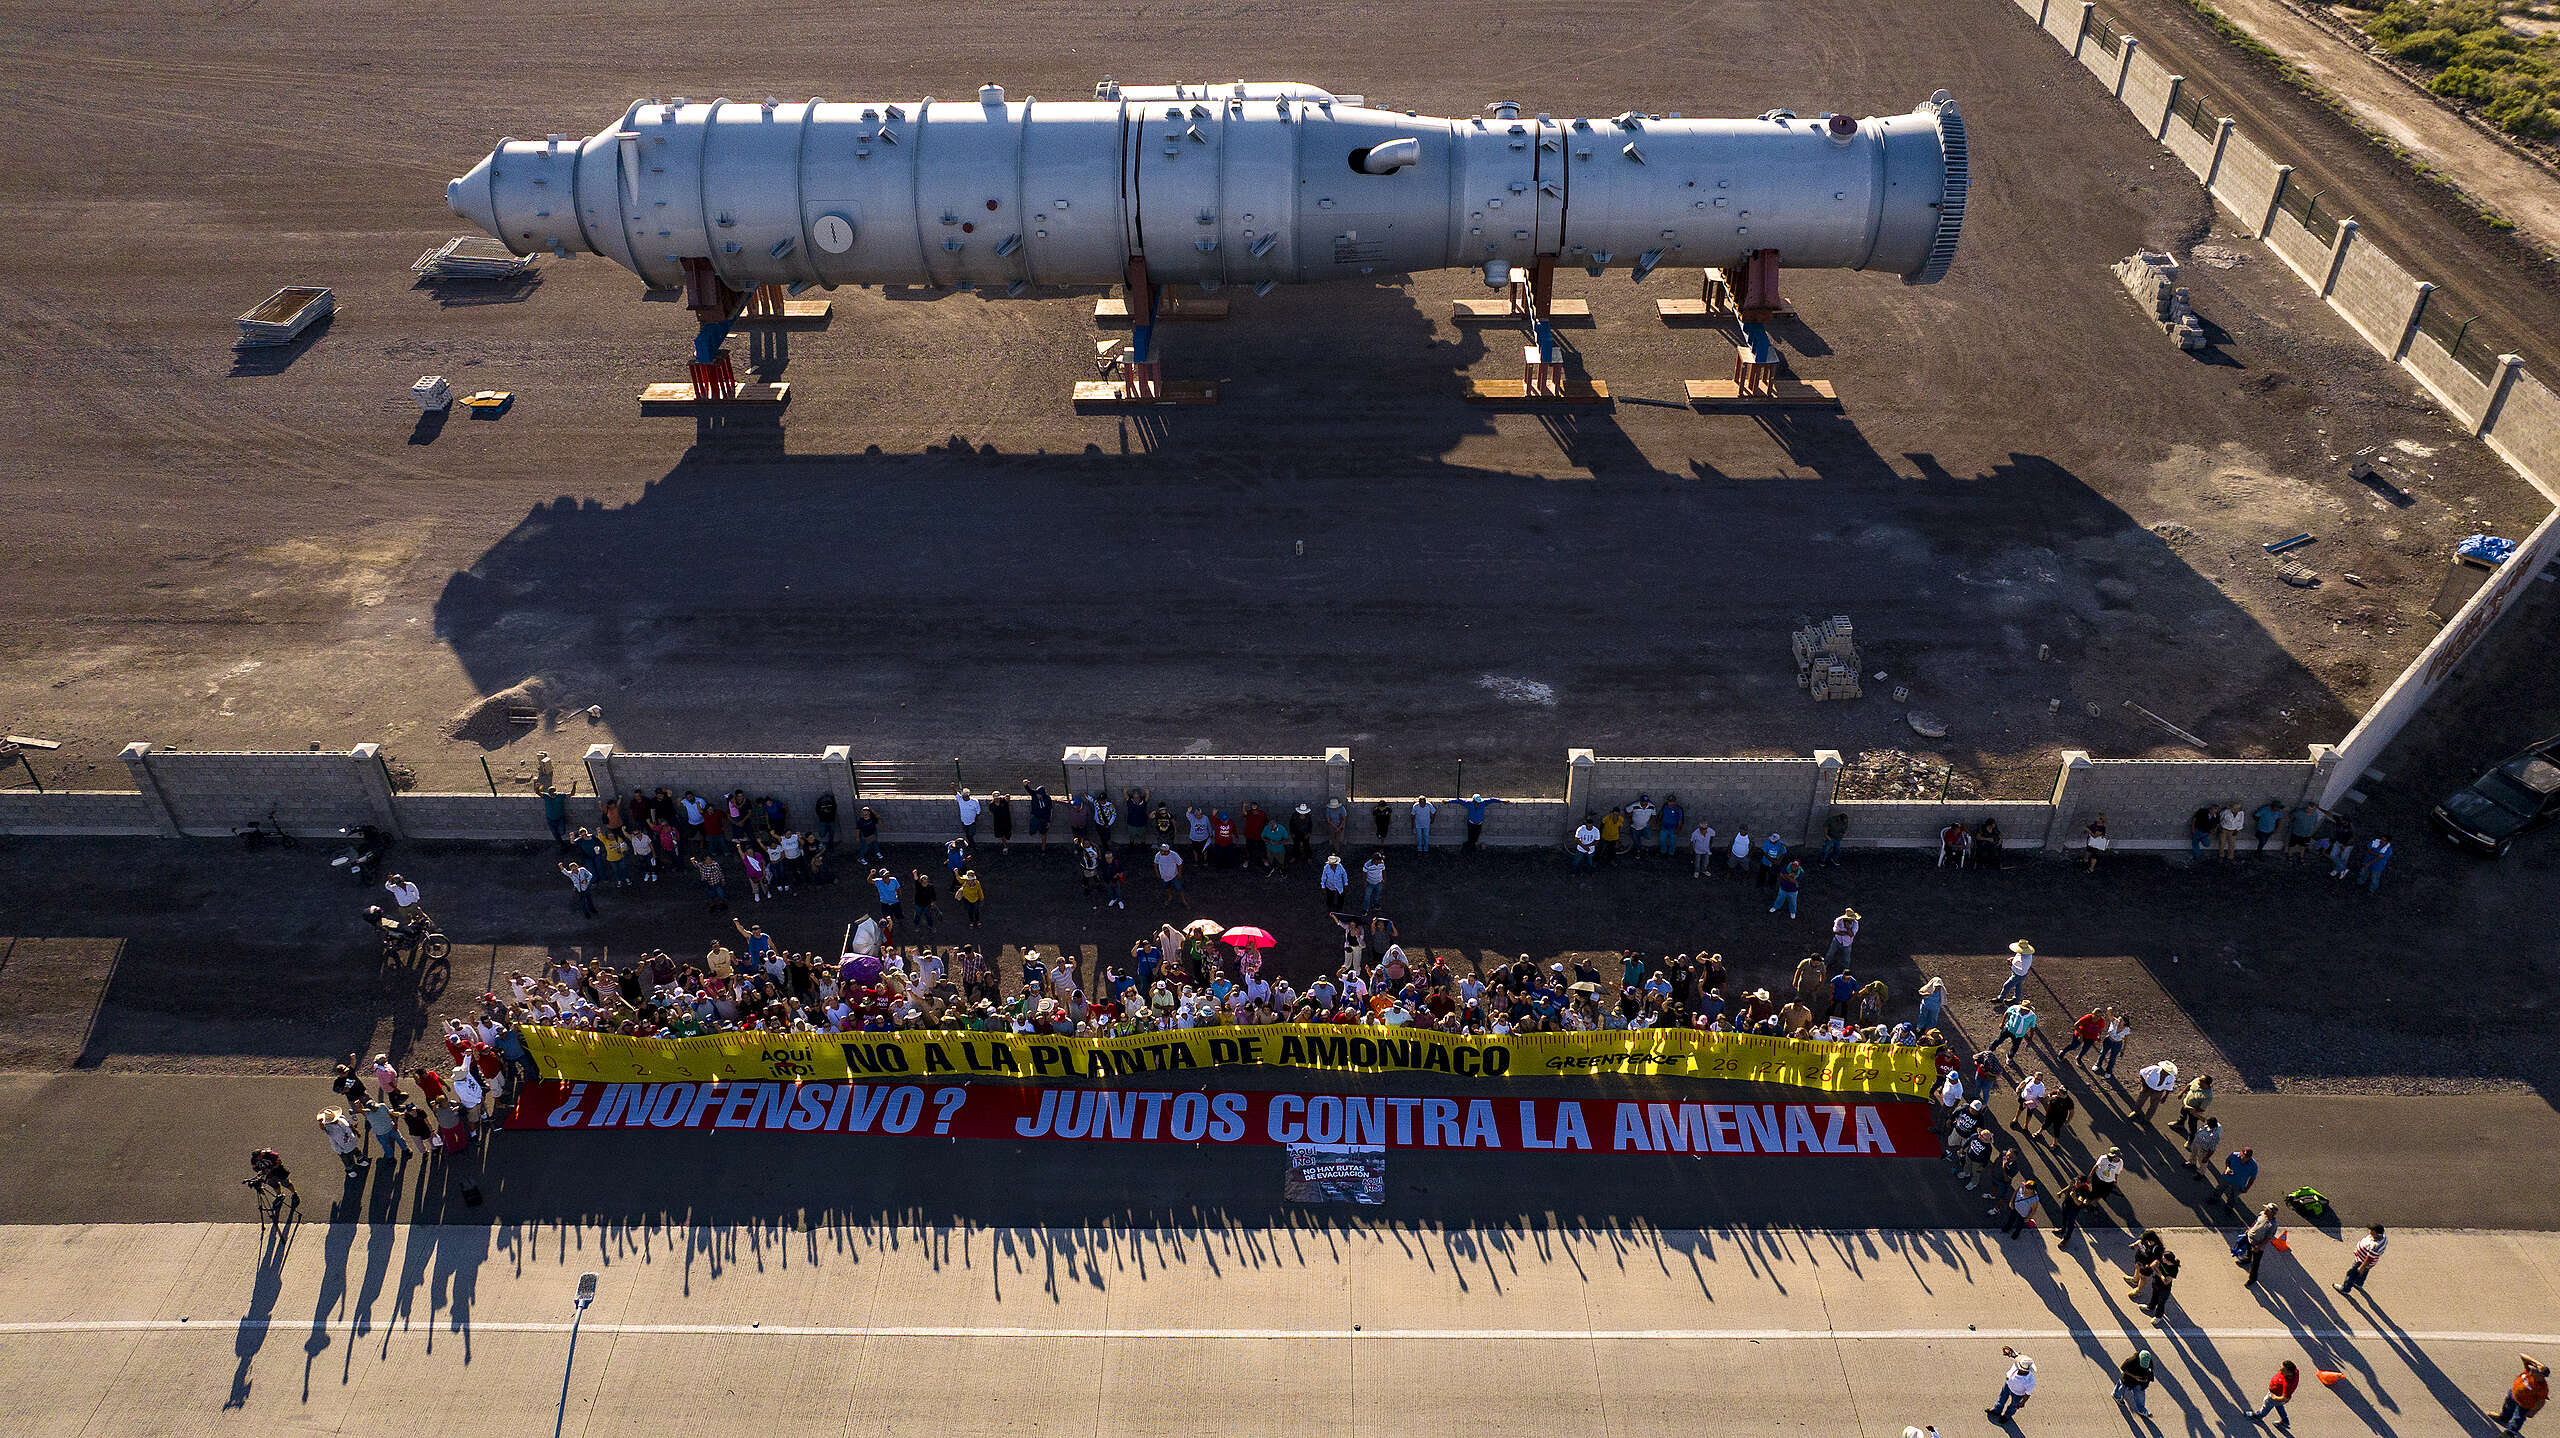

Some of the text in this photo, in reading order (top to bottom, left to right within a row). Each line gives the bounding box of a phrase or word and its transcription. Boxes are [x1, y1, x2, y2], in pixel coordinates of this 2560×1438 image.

[543, 1055, 737, 1077] 0 1 2 3 4
[840, 1035, 1510, 1079] NO A LA PLANTA DE AMONIACO
[1546, 1053, 1686, 1070] GREENPEACE
[1712, 1058, 1926, 1086] 26 27 28 29 30
[1015, 1090, 1248, 1142] JUNTOS
[1267, 1094, 1501, 1147] CONTRA
[1519, 1100, 1593, 1150] LA
[1613, 1102, 1896, 1153] AMENAZA
[1303, 1164, 1365, 1175] NO HAY RUTAS
